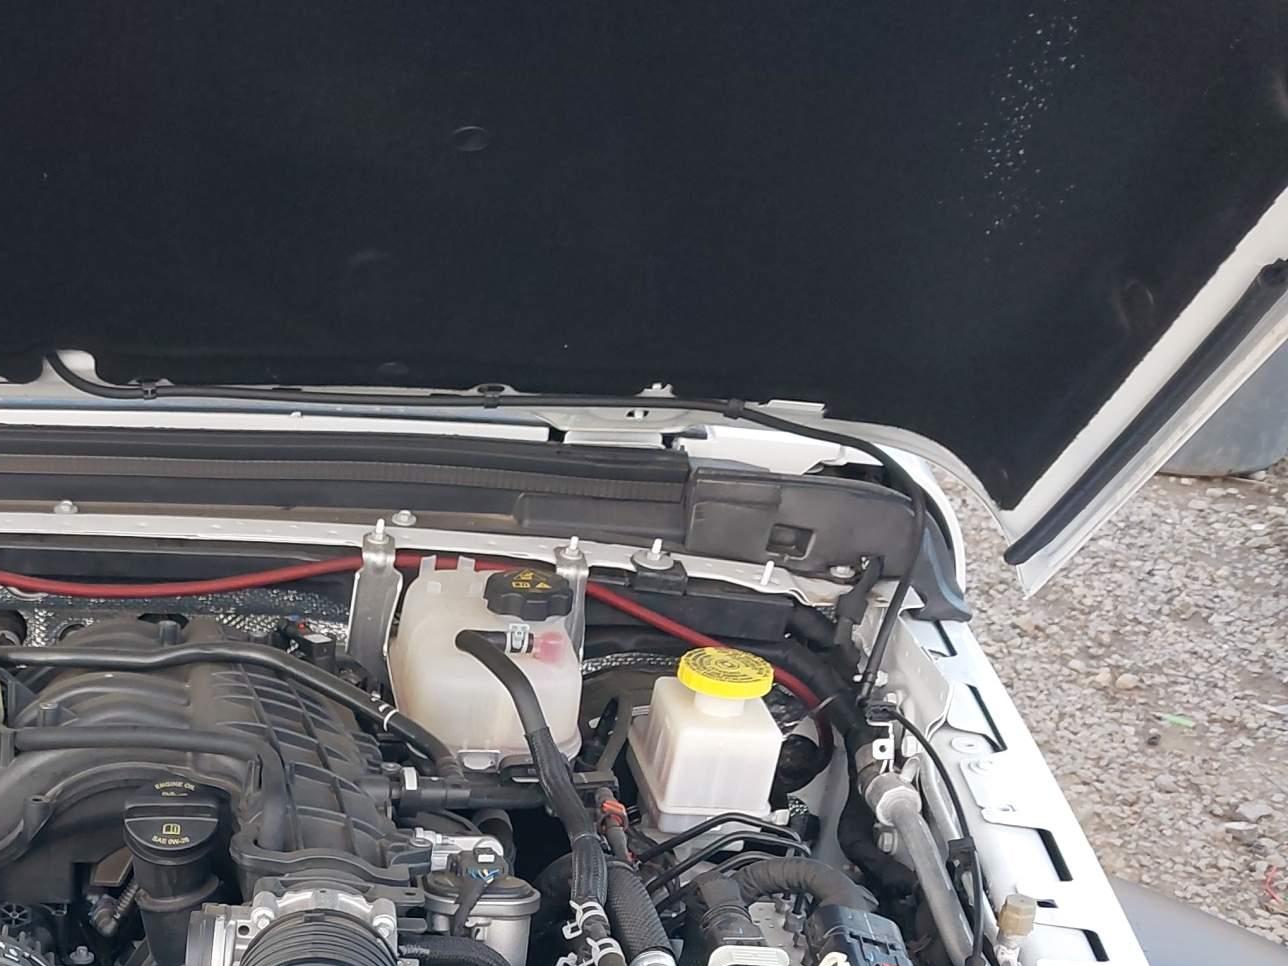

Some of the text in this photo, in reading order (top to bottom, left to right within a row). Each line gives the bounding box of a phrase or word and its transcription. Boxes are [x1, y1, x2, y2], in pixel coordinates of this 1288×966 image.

[154, 780, 196, 791] ENGINE OIL
[151, 835, 167, 845] SAE
